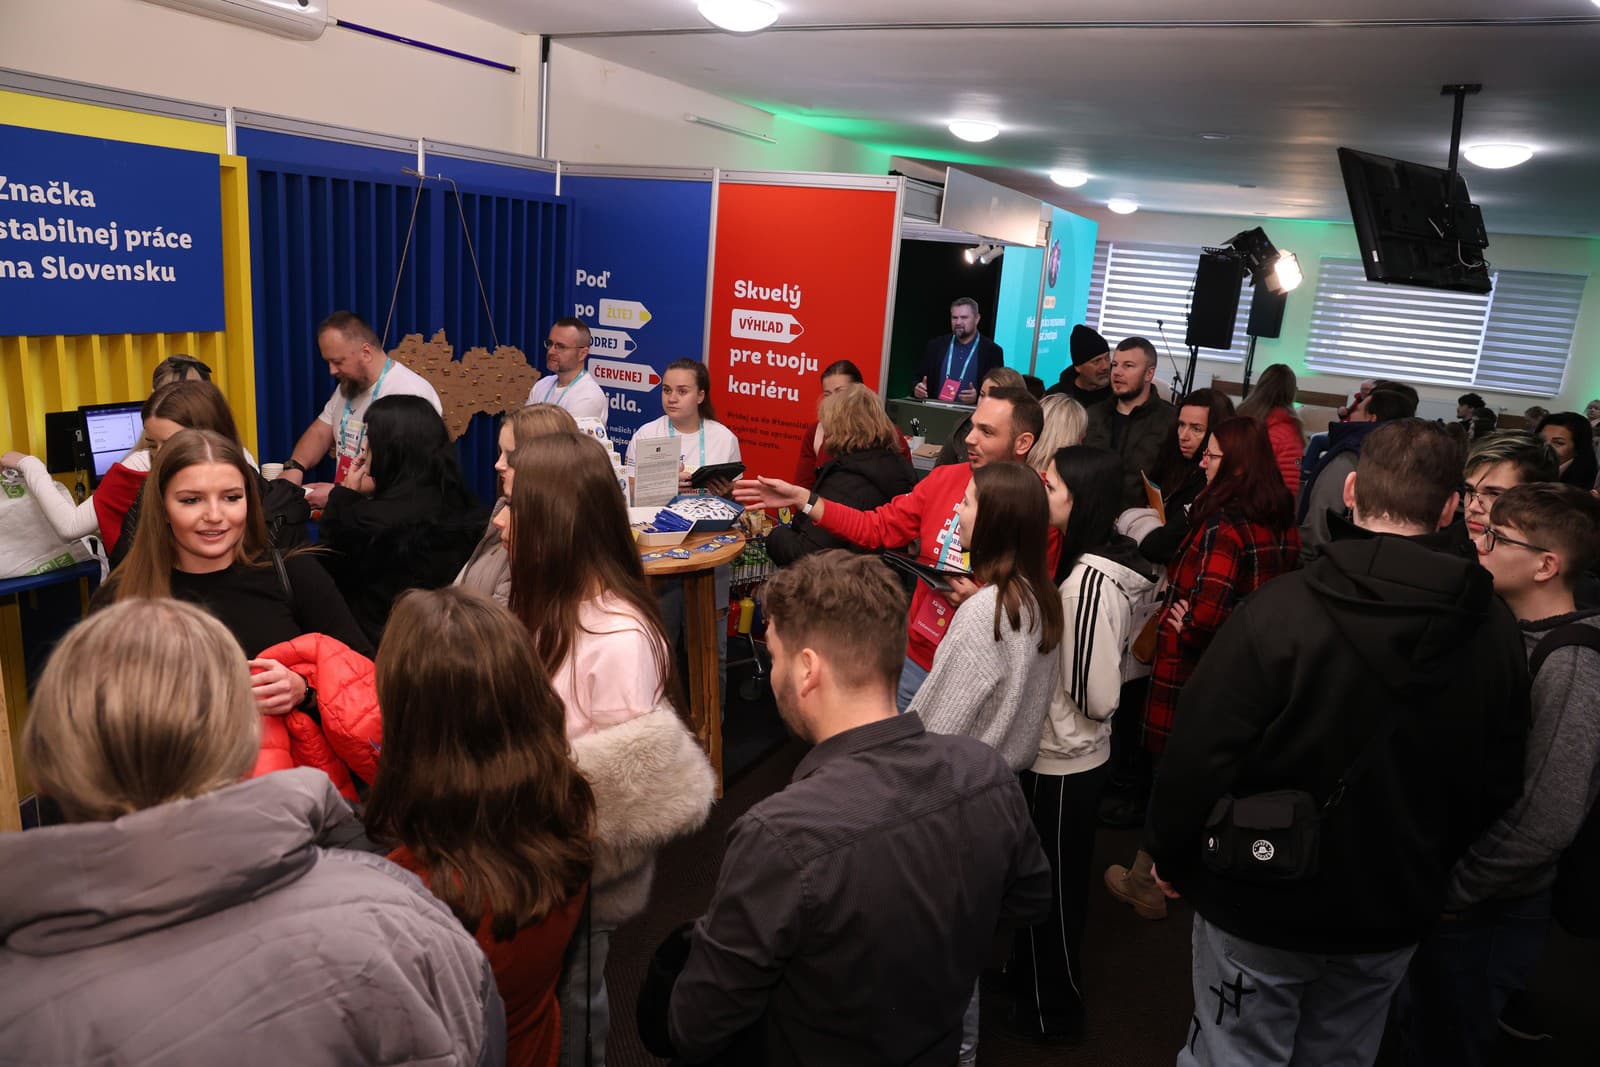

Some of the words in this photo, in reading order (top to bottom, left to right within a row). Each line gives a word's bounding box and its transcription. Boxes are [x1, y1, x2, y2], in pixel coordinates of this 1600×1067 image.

[0, 175, 96, 207] Značka
[0, 217, 118, 251] stabilnej
[124, 226, 193, 252] práce
[0, 259, 34, 279] na
[41, 256, 176, 282] Slovensku
[575, 269, 611, 288] Poď
[734, 279, 801, 309] Skvelý
[574, 303, 595, 319] po
[606, 304, 633, 320] ŽLTEJ
[739, 316, 784, 333] VÝHĽAD
[589, 335, 618, 349] ODREJ
[594, 365, 642, 383] ČERVENEJ
[730, 348, 761, 367] pre
[766, 349, 818, 375] tvoju
[728, 374, 799, 401] kariéru
